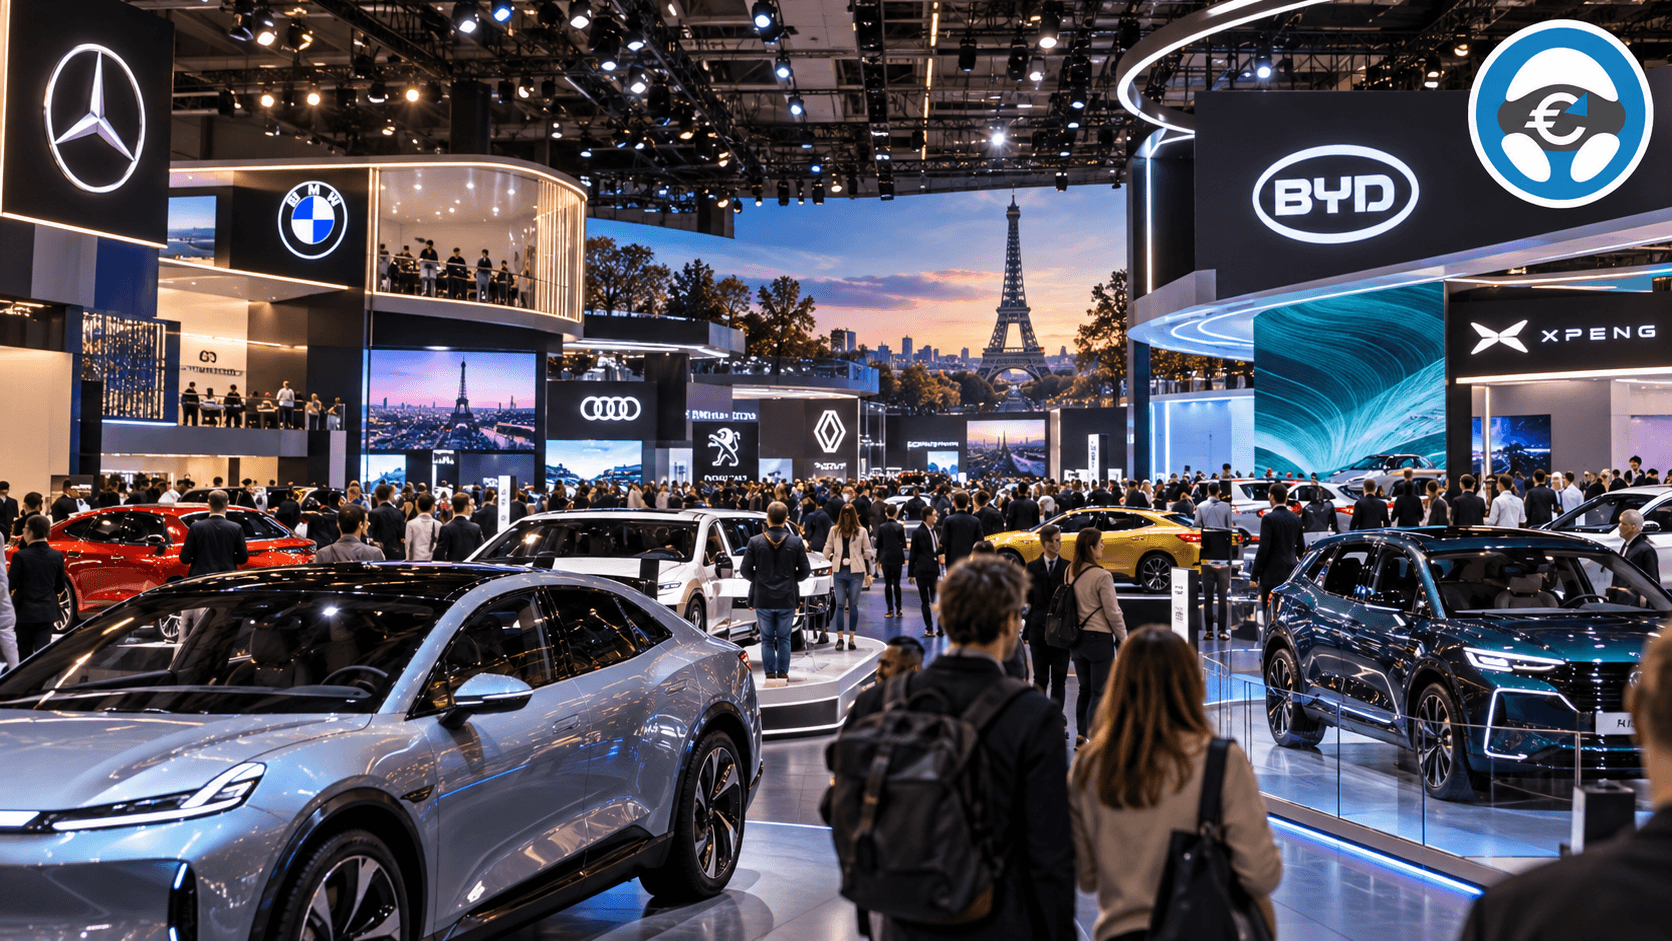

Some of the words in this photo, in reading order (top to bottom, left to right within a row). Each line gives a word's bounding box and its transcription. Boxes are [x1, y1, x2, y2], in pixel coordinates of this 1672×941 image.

[286, 184, 341, 208] BMW
[1275, 174, 1396, 217] BYD
[1541, 325, 1656, 342] XPENG
